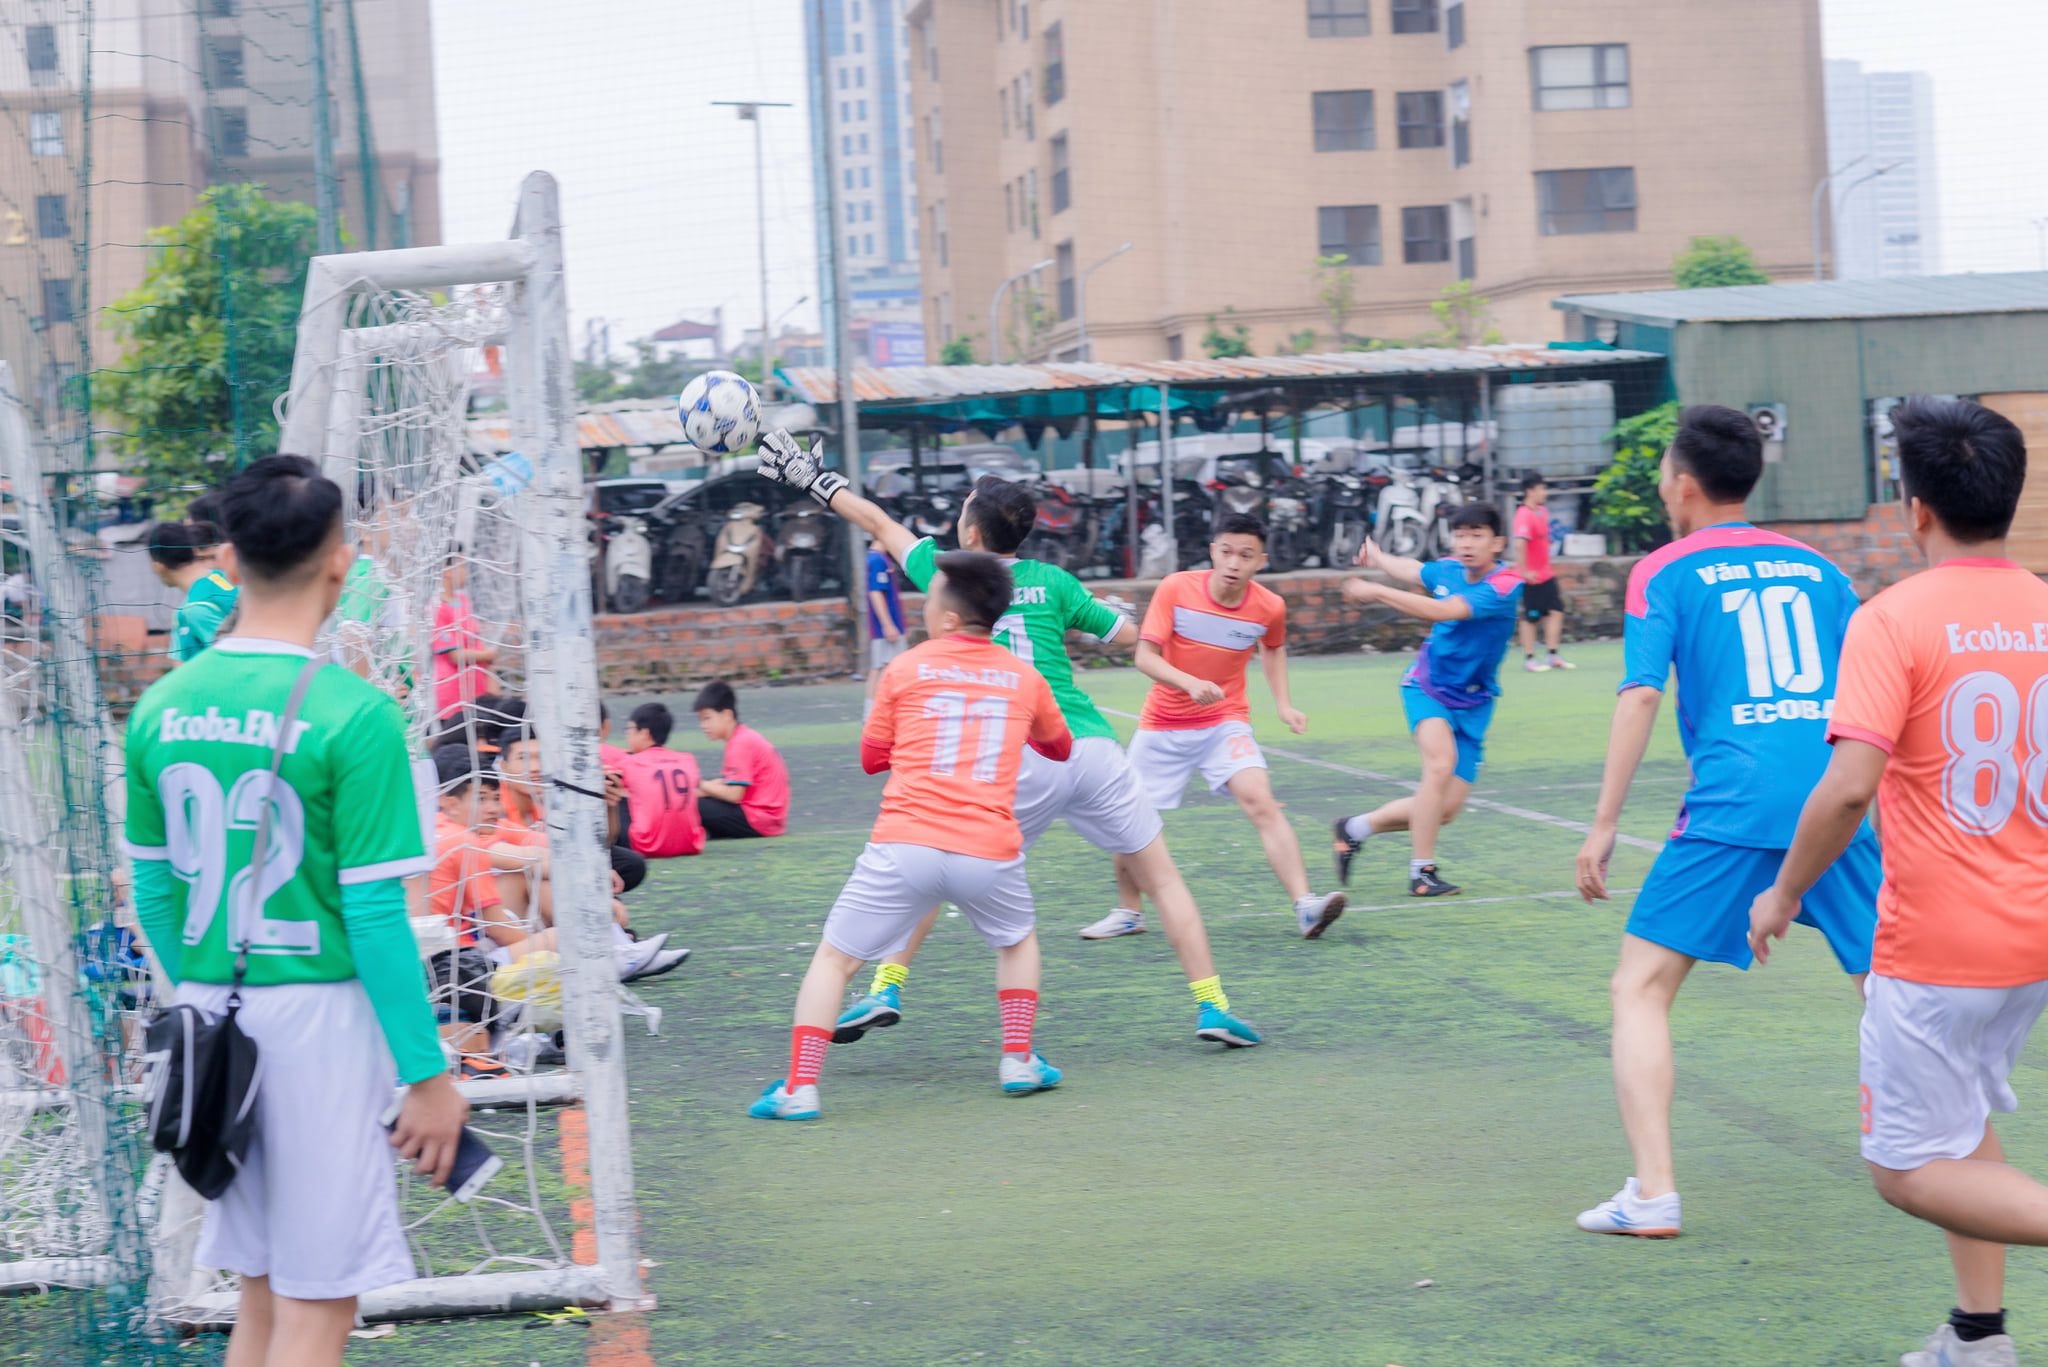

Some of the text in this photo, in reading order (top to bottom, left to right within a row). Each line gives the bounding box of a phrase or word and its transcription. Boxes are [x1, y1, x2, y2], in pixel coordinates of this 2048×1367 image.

[1696, 562, 1752, 585] Văn
[1721, 586, 1824, 697] 10
[1945, 622, 2048, 654] Ecoba.E
[159, 706, 312, 754] Ecoba.ENT
[922, 690, 1010, 784] 11
[654, 768, 689, 812] 19
[157, 761, 321, 955] 92
